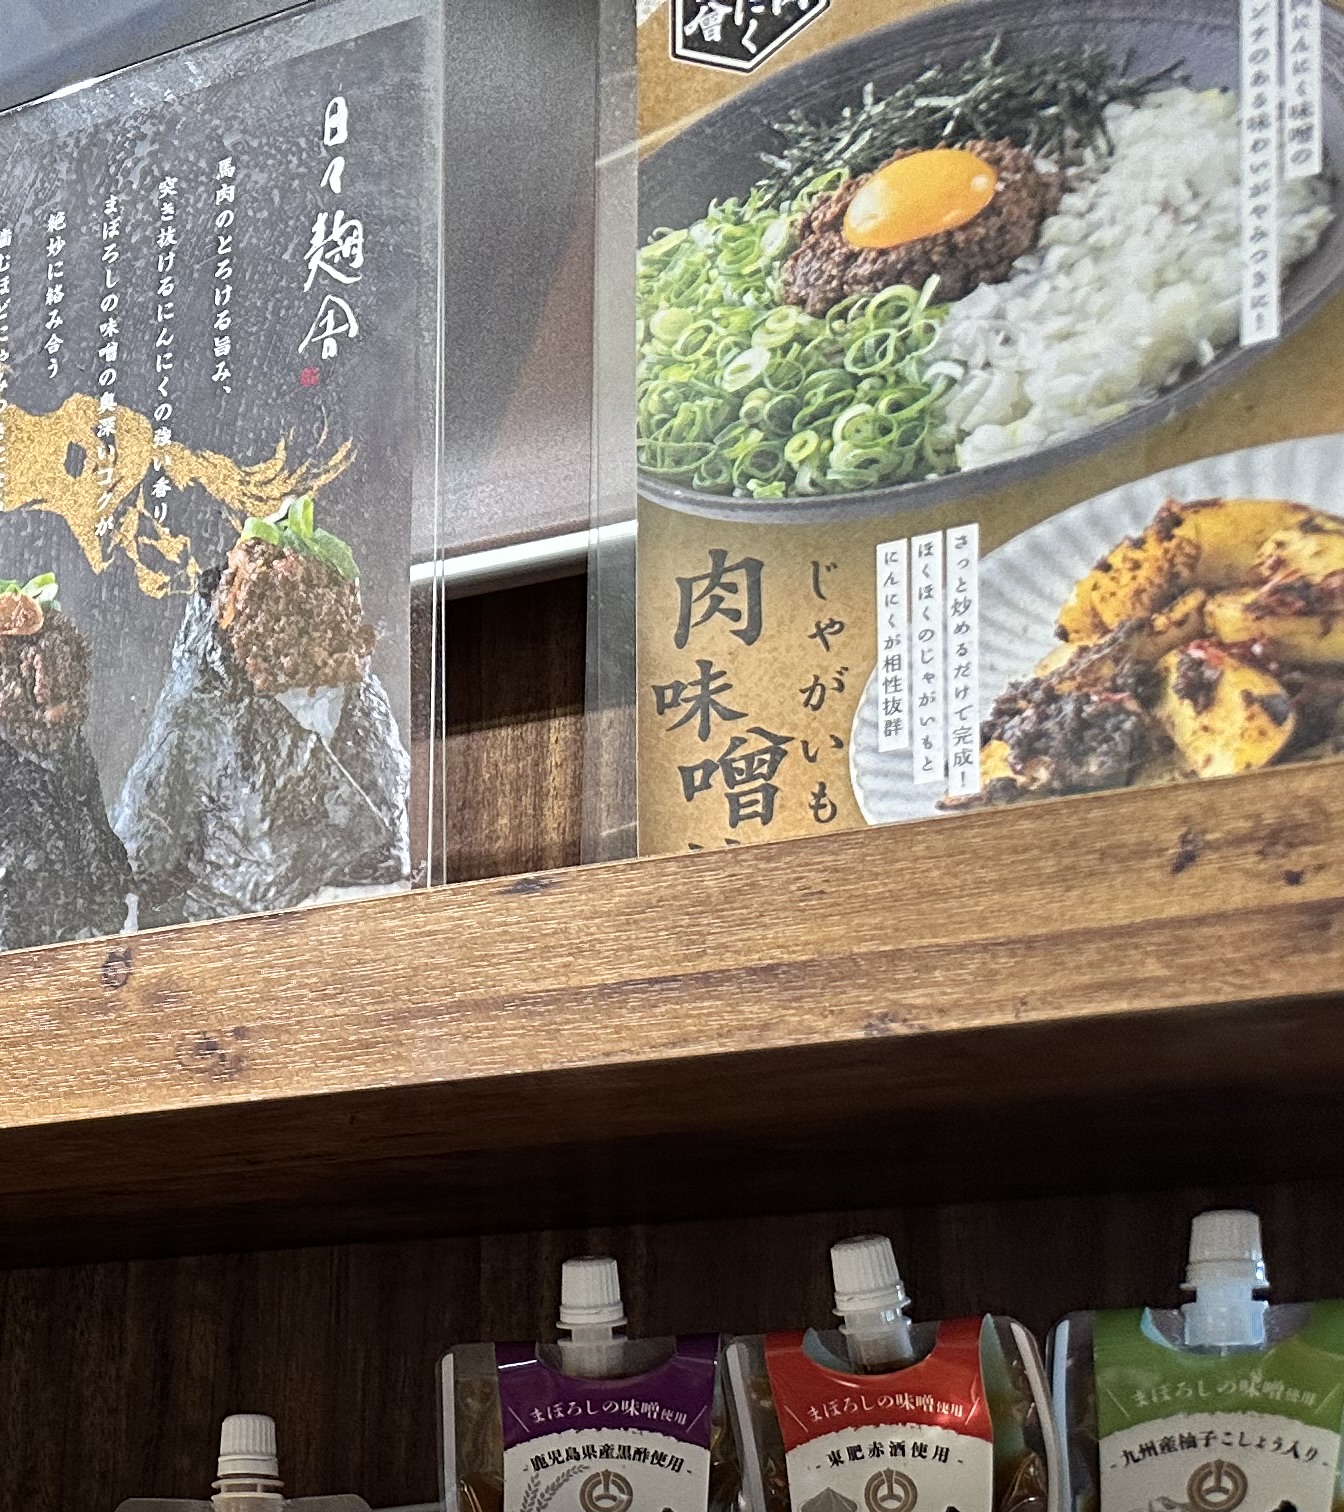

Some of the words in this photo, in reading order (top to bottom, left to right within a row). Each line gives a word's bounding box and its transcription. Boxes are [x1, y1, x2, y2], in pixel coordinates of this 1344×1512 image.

[44, 211, 67, 379] 絶妙に絡み合う
[212, 156, 236, 395] 馬肉のとろける旨み、
[299, 96, 365, 360] 日々麹舎
[650, 548, 797, 850] 肉味噌
[799, 559, 849, 824] じゃがいも
[882, 550, 904, 737] にんにくが相性抜群
[917, 541, 937, 773] ほくほくのじゃがいもと
[529, 1398, 688, 1426] まぼろしの味噌使用
[529, 1443, 686, 1473] 鹿児島県産黒酢使用
[806, 1391, 965, 1425] まぼろしの味噌使用
[826, 1438, 953, 1472] 東肥赤酒使用
[1120, 1430, 1319, 1466] 九州産柚子こしょう入り
